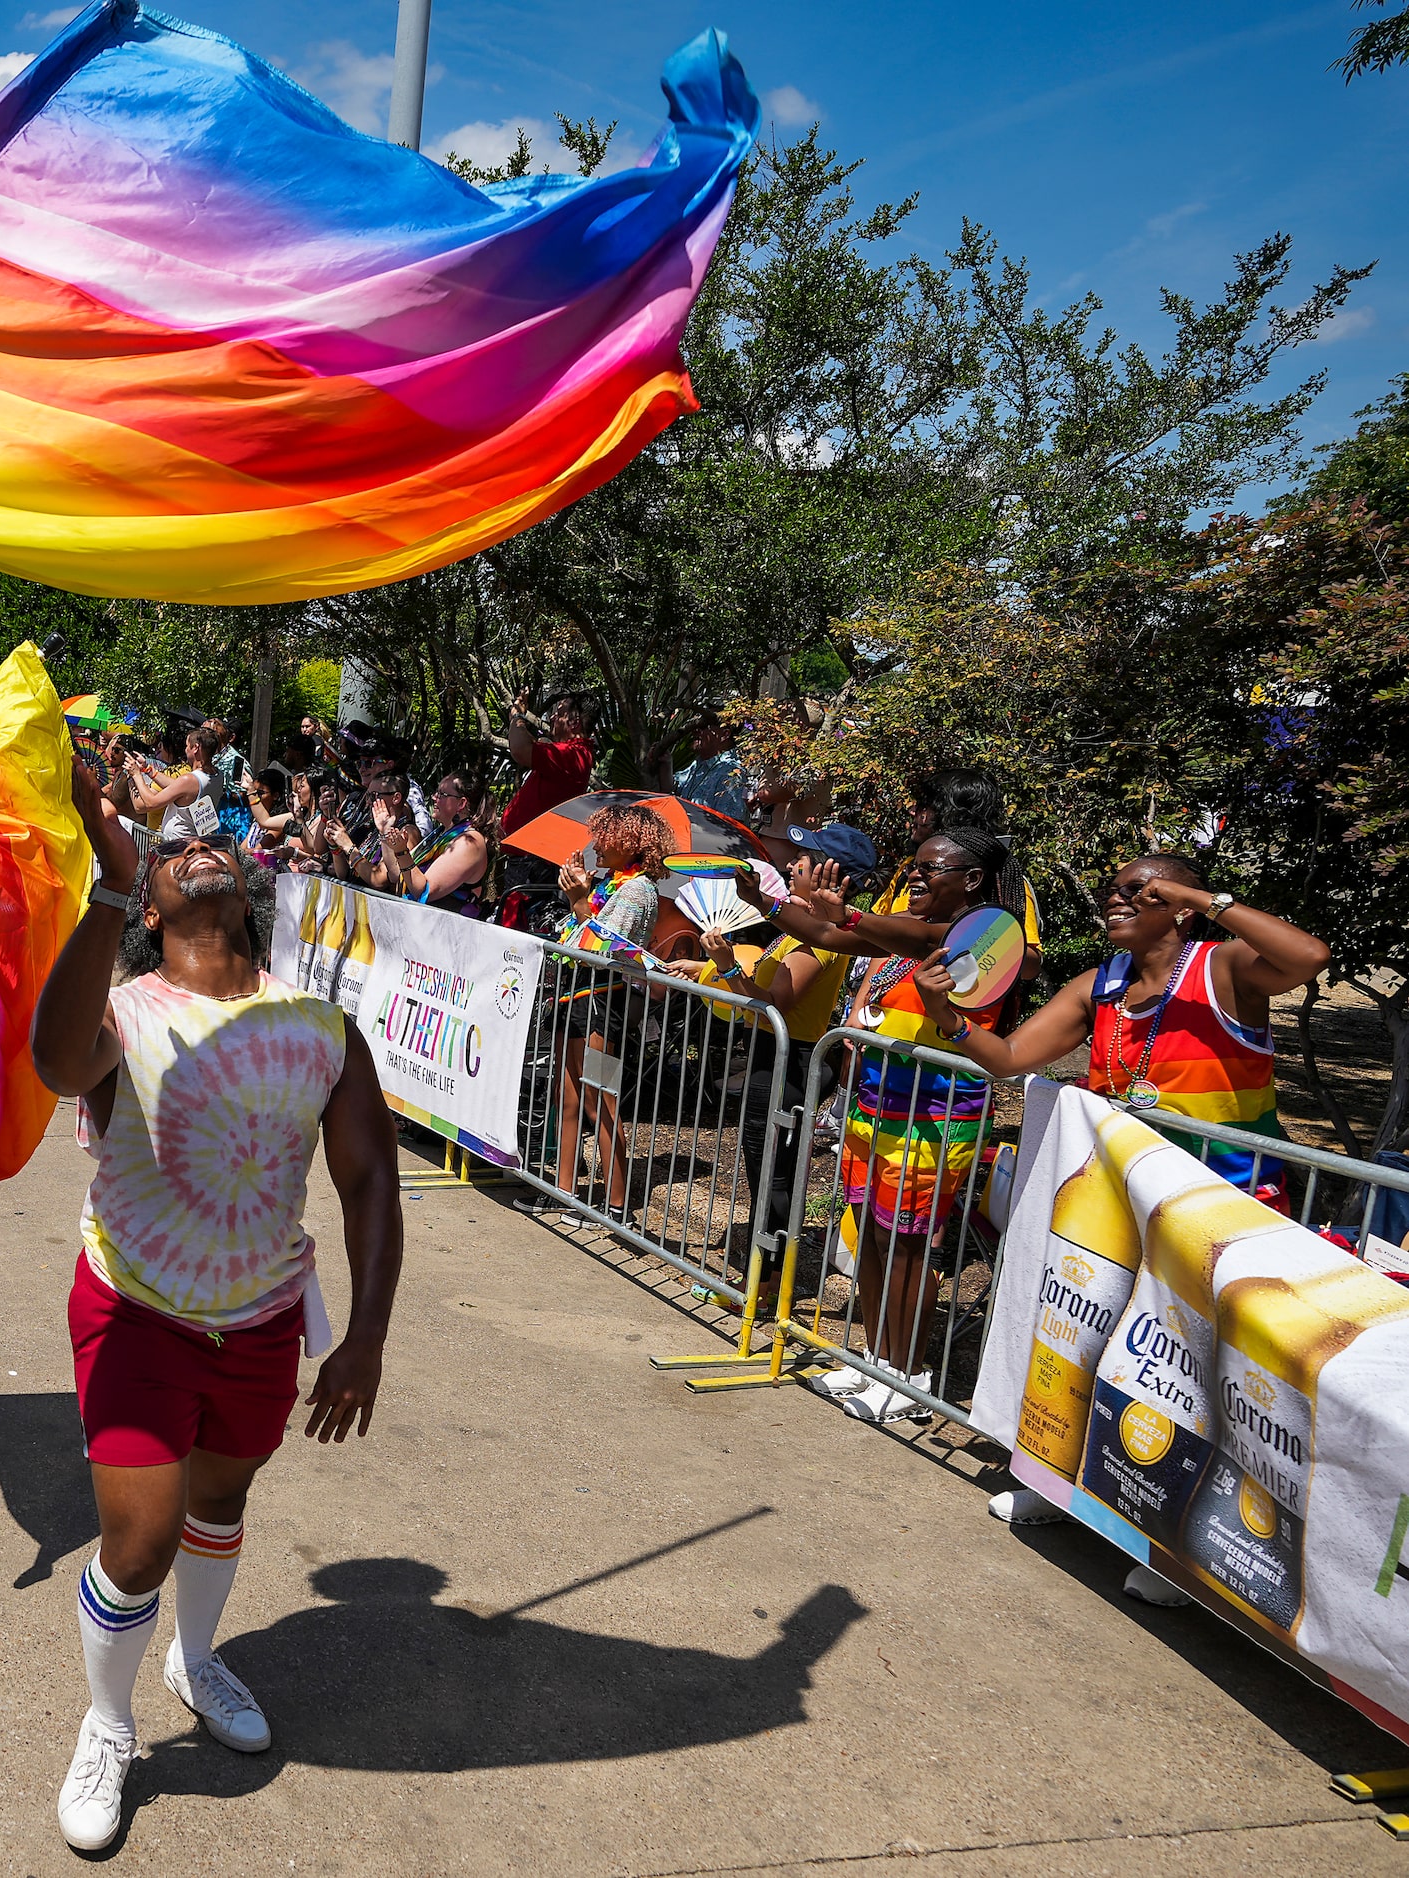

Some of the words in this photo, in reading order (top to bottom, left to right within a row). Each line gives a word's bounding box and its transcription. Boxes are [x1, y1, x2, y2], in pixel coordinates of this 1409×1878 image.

[337, 970, 364, 995] Corona
[401, 958, 474, 1010] REFRESHINGLY
[371, 990, 482, 1078] AUTHENTIC
[385, 1050, 407, 1073] THAT'S
[409, 1060, 421, 1081] THE
[422, 1067, 437, 1088] FINE
[438, 1074, 455, 1096] LIFE
[1041, 1306, 1079, 1346] Light
[1045, 1352, 1054, 1363] LA
[1126, 1312, 1208, 1390] Coron
[1036, 1355, 1062, 1378] CERVEZA
[1040, 1367, 1053, 1381] MAS
[1038, 1375, 1051, 1390] FINA
[1135, 1359, 1194, 1413] Extra
[1024, 1417, 1044, 1438] MEXICO
[1042, 1419, 1066, 1440] MODELO
[1127, 1414, 1167, 1443] CERVEZA
[1144, 1413, 1158, 1426] LA
[1221, 1376, 1302, 1466] Corona
[1129, 1437, 1149, 1456] FINA
[1132, 1428, 1153, 1446] MAS
[1224, 1425, 1299, 1512] PREMIER
[1103, 1459, 1138, 1494] CERVECERIA
[1138, 1487, 1162, 1511] MODELO
[1120, 1482, 1142, 1507] MEXICO
[1117, 1497, 1125, 1510] 12
[1207, 1514, 1240, 1539] Brewed
[1234, 1536, 1256, 1550] and
[1250, 1544, 1281, 1569] Bottled
[1207, 1529, 1252, 1567] CERVECERIA
[1250, 1560, 1282, 1586] MODELO
[1224, 1554, 1255, 1580] MEXICO
[1210, 1561, 1228, 1581] BEER
[1229, 1575, 1238, 1589] 12
